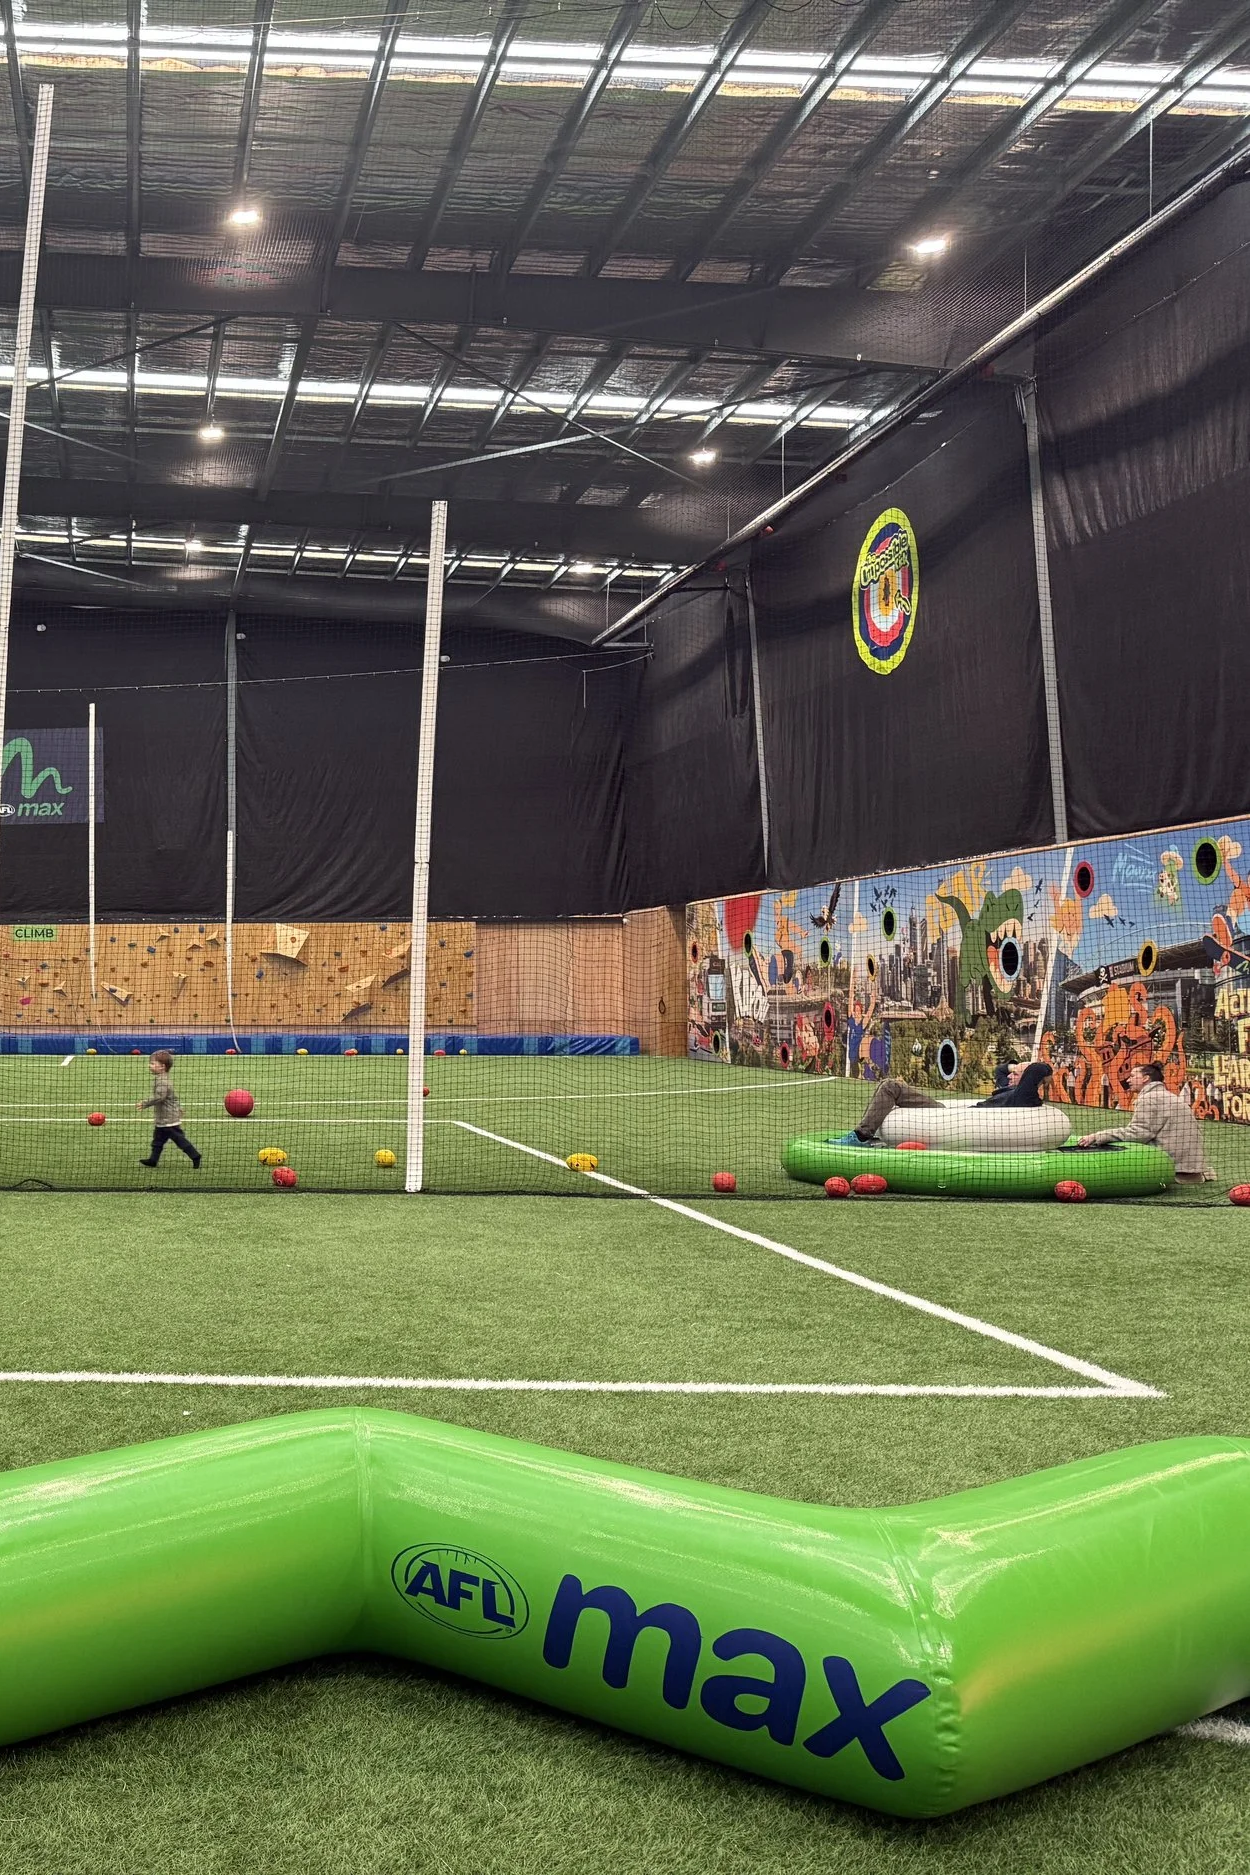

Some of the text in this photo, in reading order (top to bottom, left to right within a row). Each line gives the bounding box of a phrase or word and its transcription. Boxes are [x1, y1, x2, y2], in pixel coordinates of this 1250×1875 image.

[17, 802, 65, 817] max
[15, 928, 54, 938] CLIMB
[405, 1560, 931, 1781] AFL max
